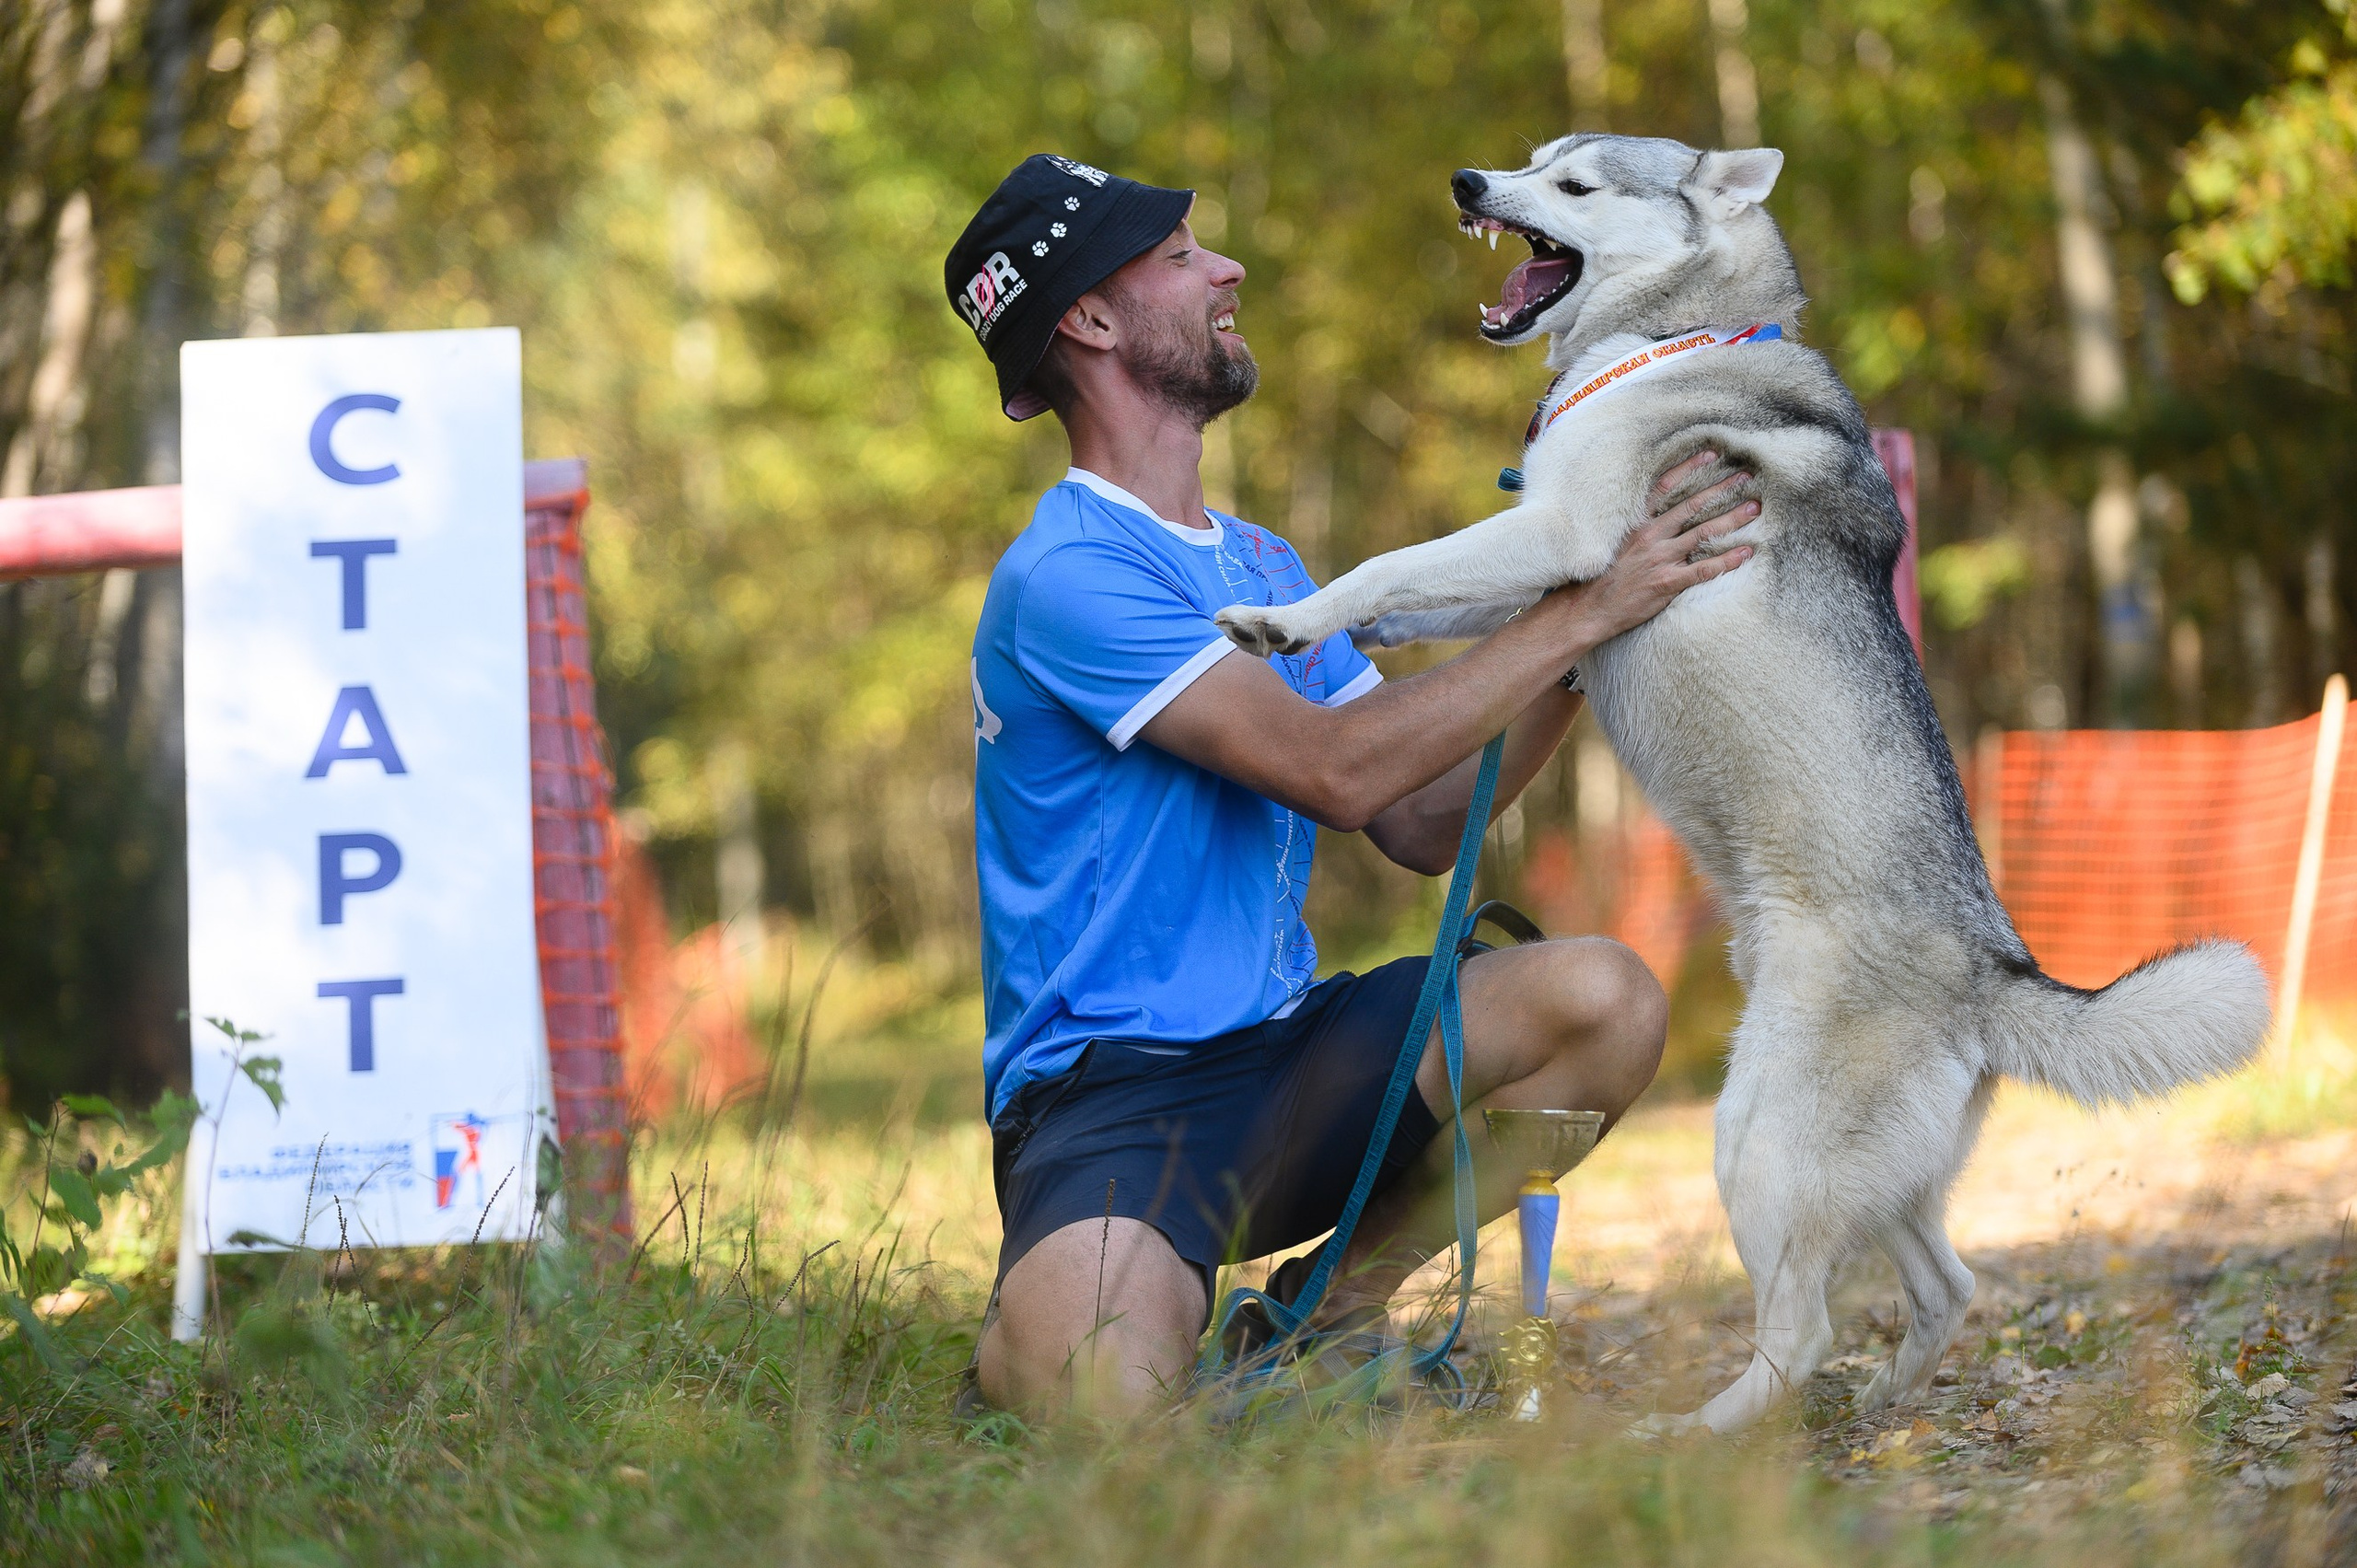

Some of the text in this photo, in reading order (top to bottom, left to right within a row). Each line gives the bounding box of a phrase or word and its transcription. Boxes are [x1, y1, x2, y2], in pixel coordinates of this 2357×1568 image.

[958, 251, 1020, 331] CDR
[989, 301, 1005, 322] DOG
[1003, 278, 1028, 306] RACE
[305, 393, 409, 1072] СТАРТ
